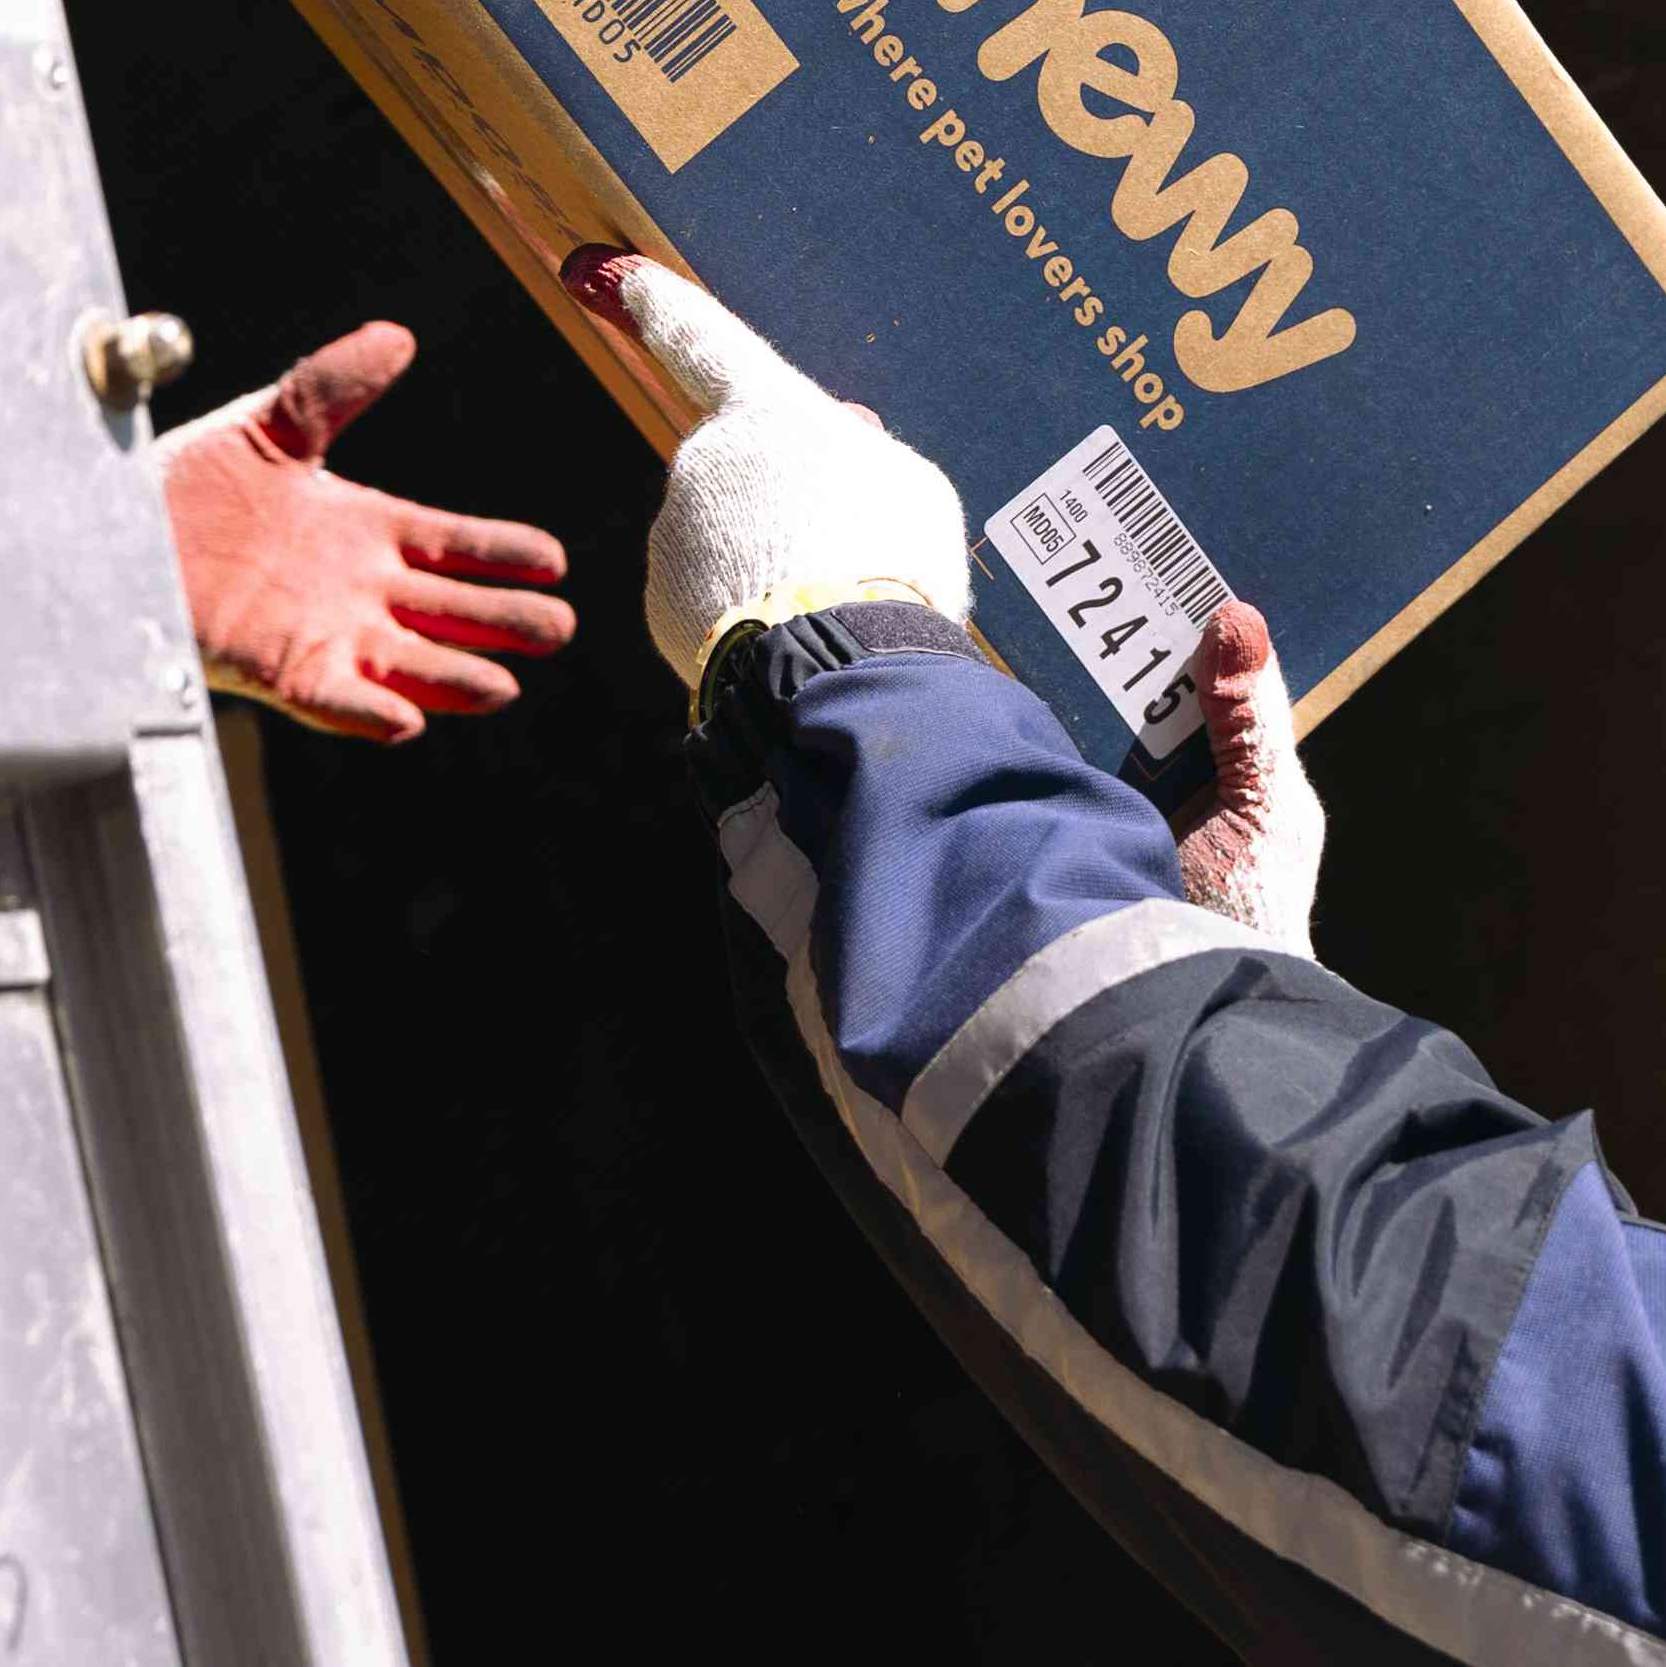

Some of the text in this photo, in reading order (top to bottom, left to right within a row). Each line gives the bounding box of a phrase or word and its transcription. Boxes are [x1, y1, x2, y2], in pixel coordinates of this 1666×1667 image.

[918, 108, 1006, 194] pet
[990, 179, 1105, 328] lovers
[1095, 324, 1186, 432] shop
[1022, 504, 1065, 554] MD05
[1058, 488, 1089, 524] 1400
[1045, 539, 1197, 726] 72415
